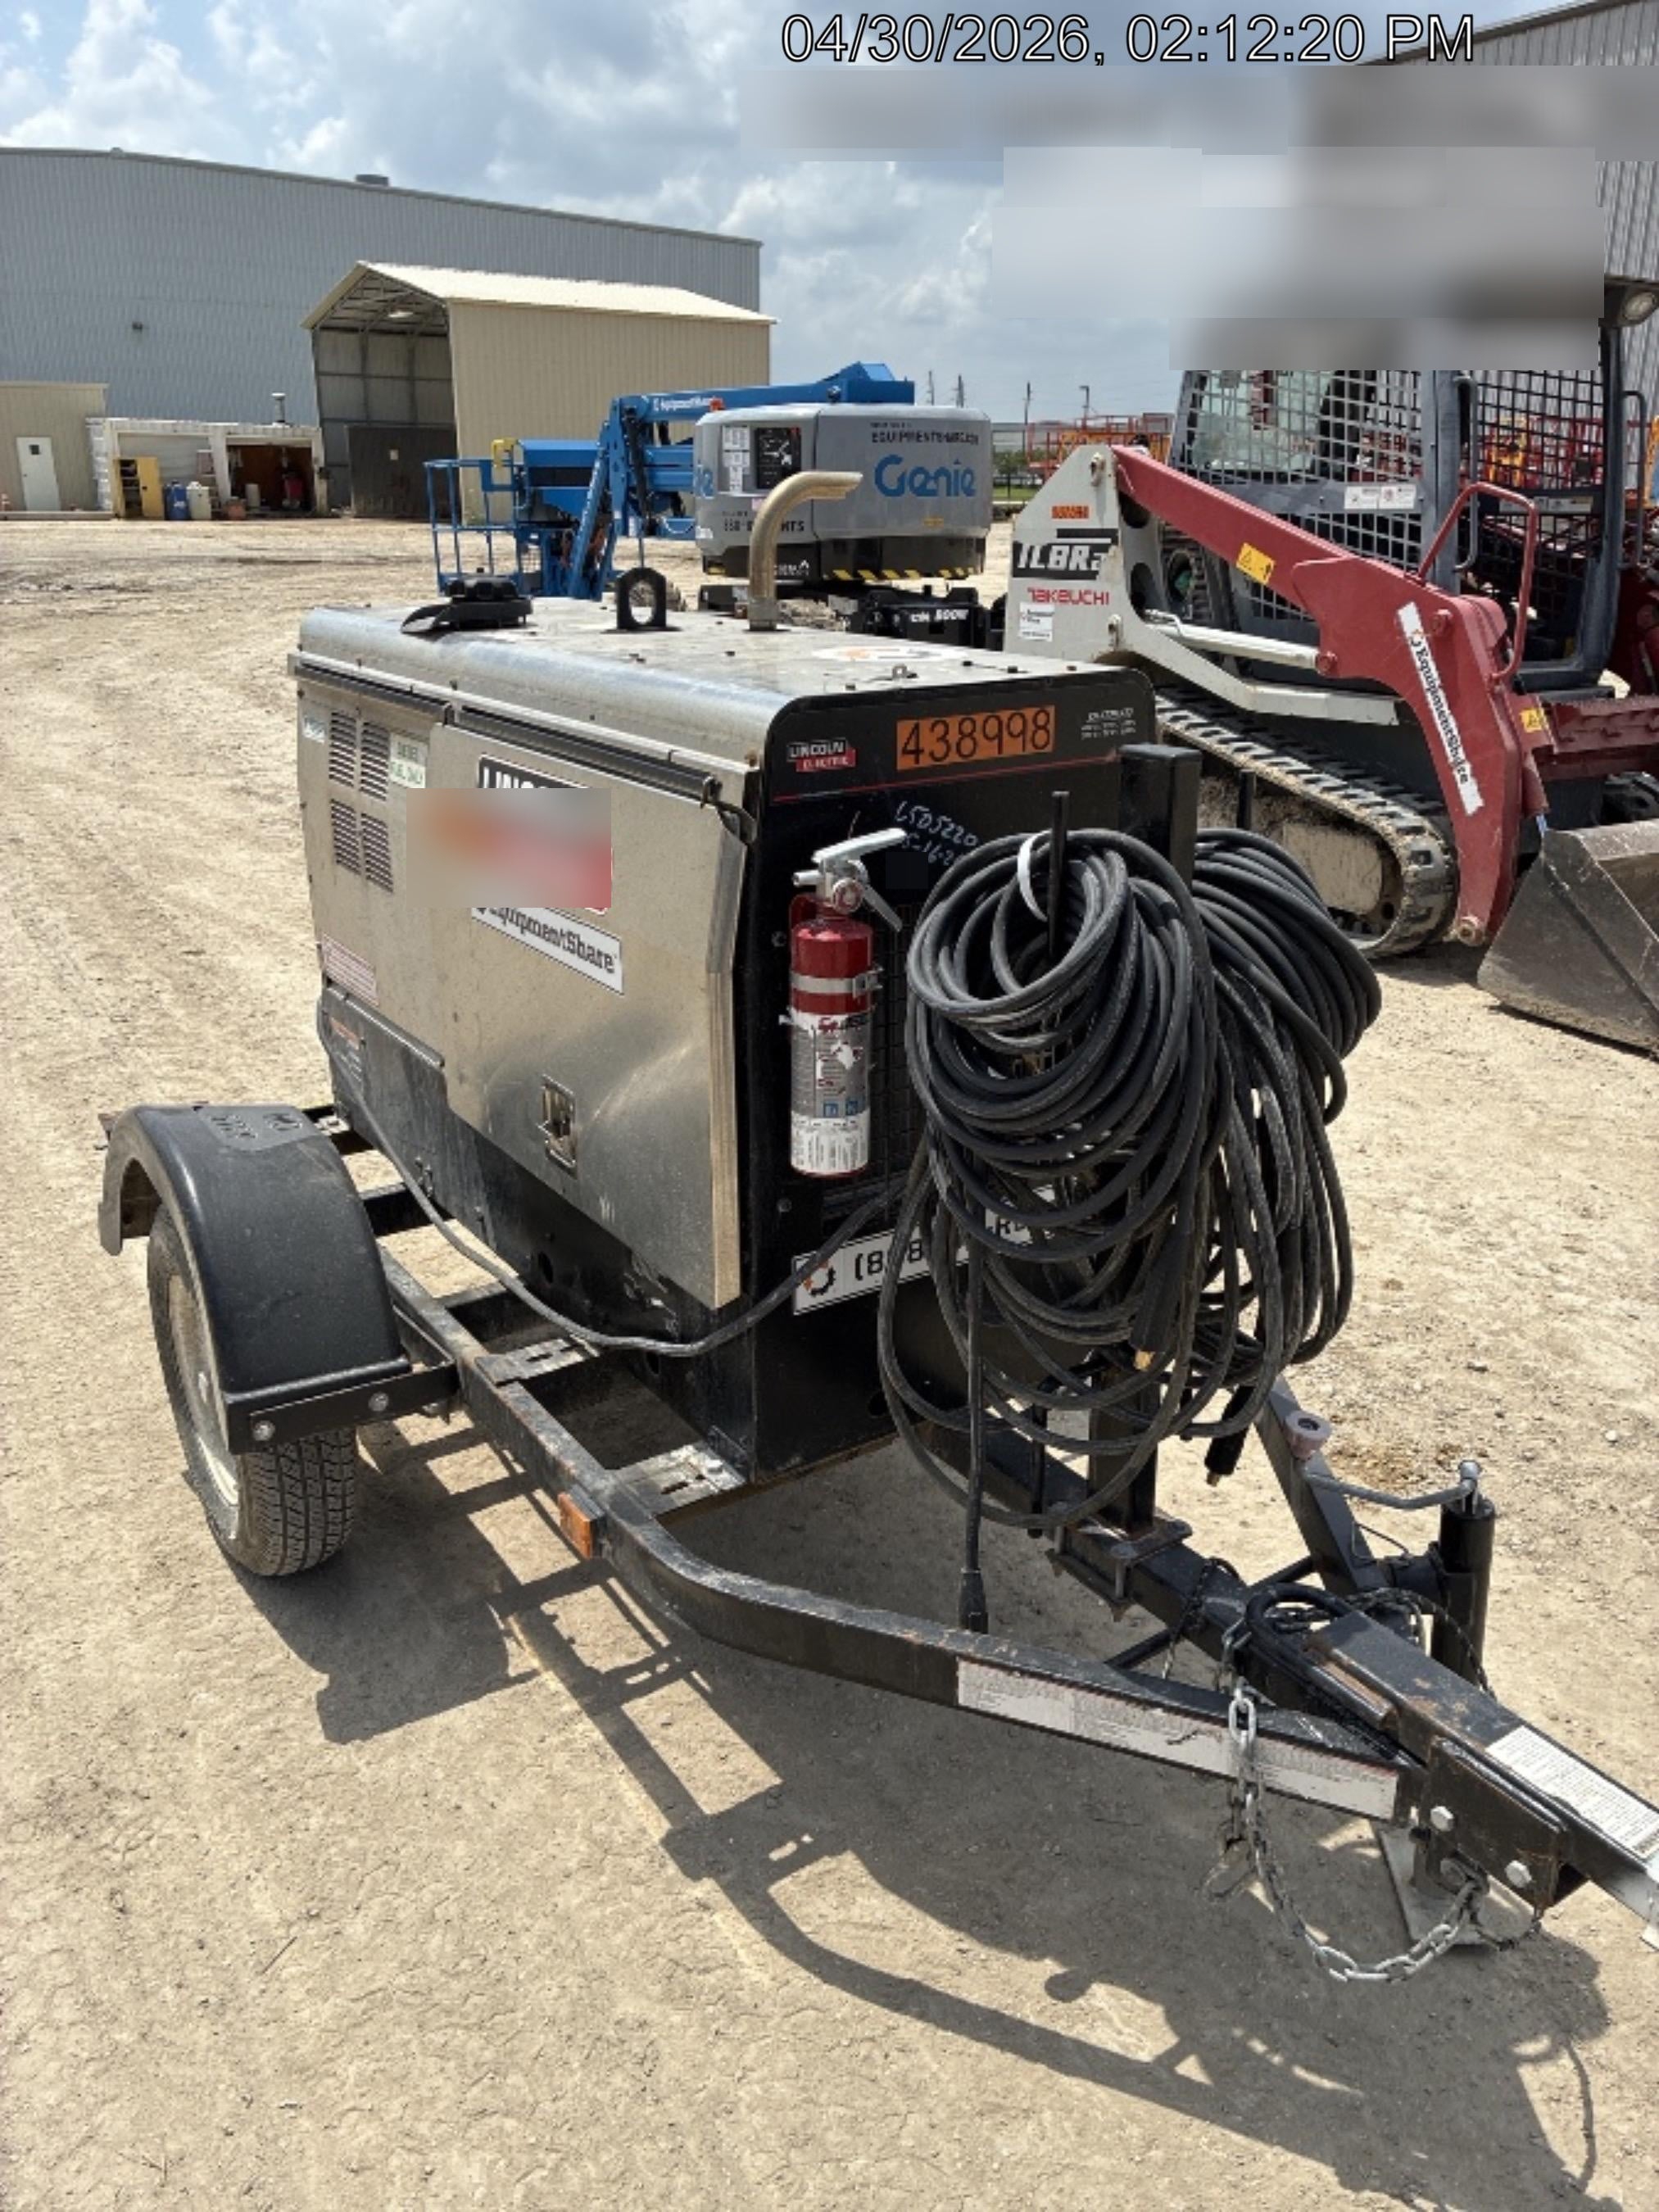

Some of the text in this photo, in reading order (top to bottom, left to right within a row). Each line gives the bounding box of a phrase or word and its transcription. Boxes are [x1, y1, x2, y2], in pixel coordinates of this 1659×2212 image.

[874, 454, 977, 497] Genie
[1027, 588, 1110, 605] TAKEUCHI
[1415, 643, 1470, 785] EquipmentShare
[789, 739, 845, 759] LINCOLN
[900, 708, 1051, 765] 438998
